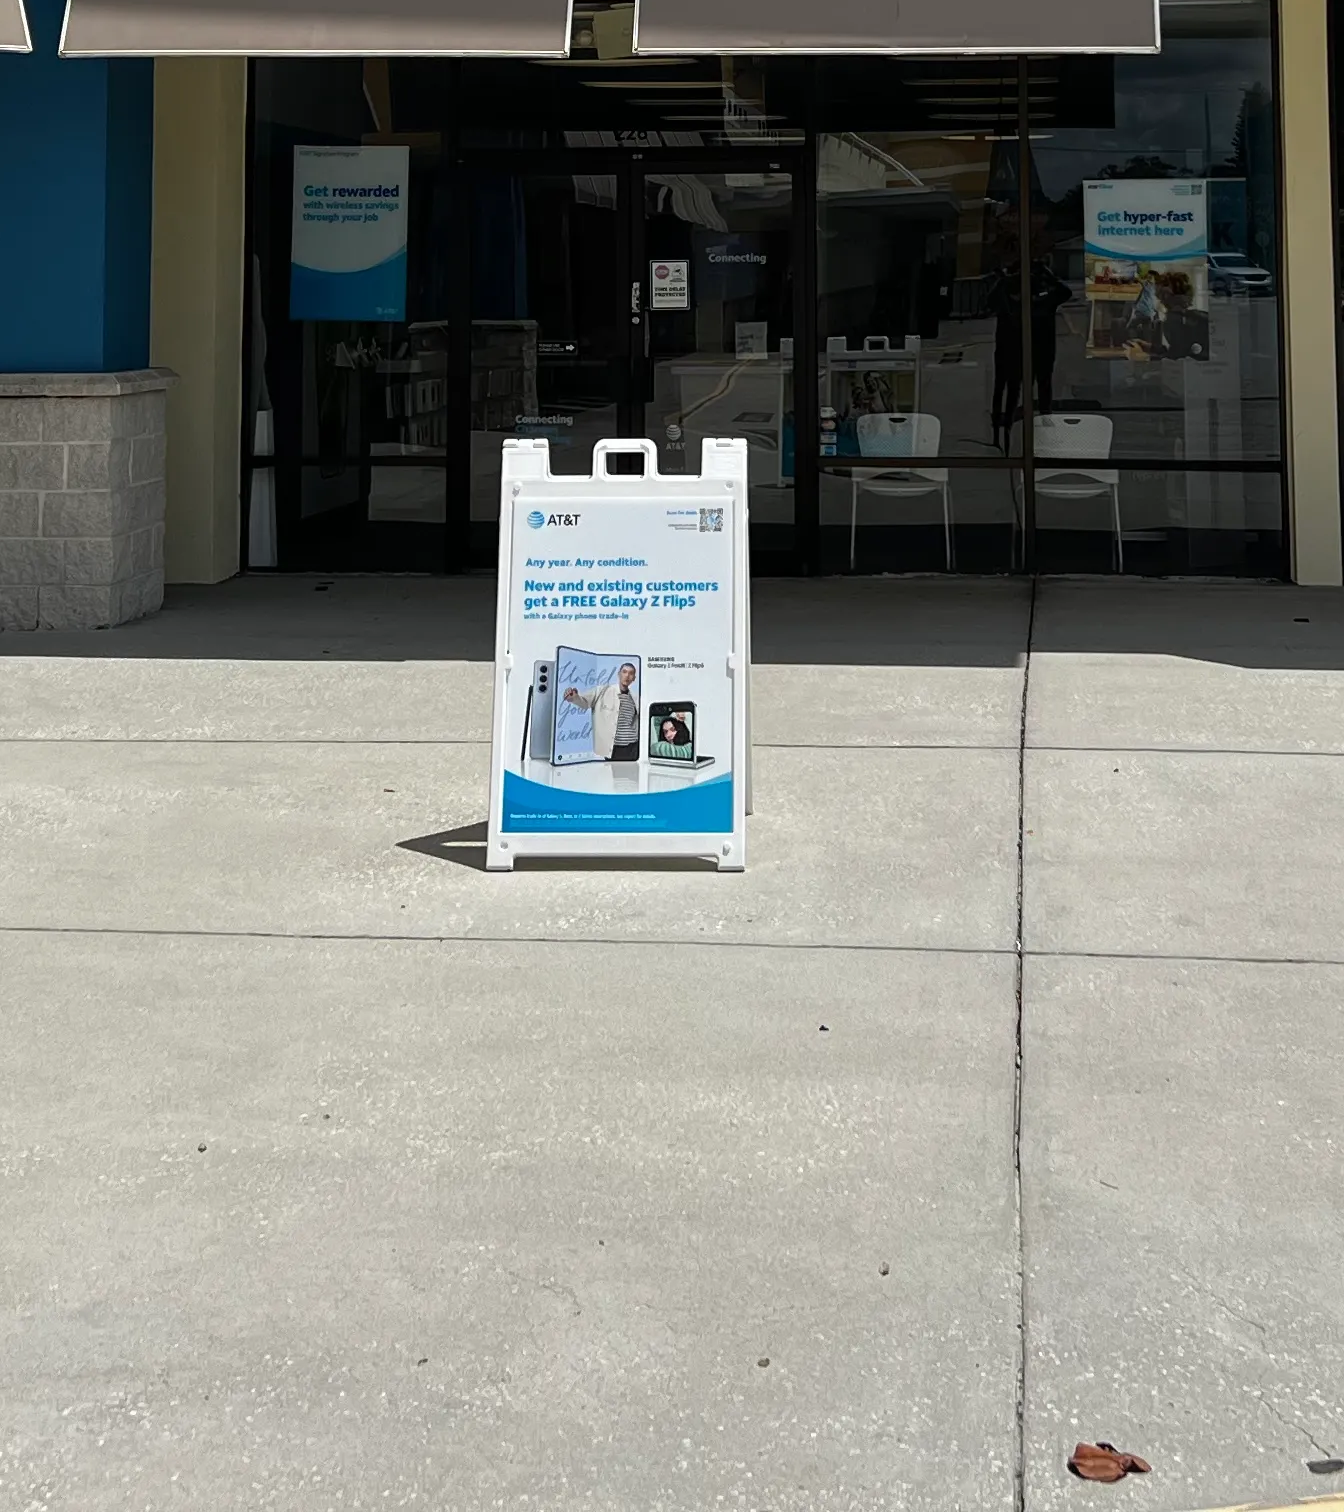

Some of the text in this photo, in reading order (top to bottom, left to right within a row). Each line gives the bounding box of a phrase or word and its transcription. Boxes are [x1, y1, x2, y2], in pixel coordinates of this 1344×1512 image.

[303, 184, 399, 197] Get rewarded
[303, 200, 399, 211] with wireless savings
[303, 213, 379, 223] through your job
[1097, 210, 1194, 225] Get hyper-fast
[1098, 225, 1184, 236] internet here
[708, 252, 768, 265] Connecting
[515, 413, 574, 427] Connecting
[547, 514, 581, 526] AT&T
[525, 558, 648, 569] Any year. Any condition.
[524, 579, 718, 594] New and existing customers
[524, 595, 696, 610] get a FREE Galaxy Z Flip5
[548, 613, 573, 621] Galaxy
[574, 613, 597, 621] phone
